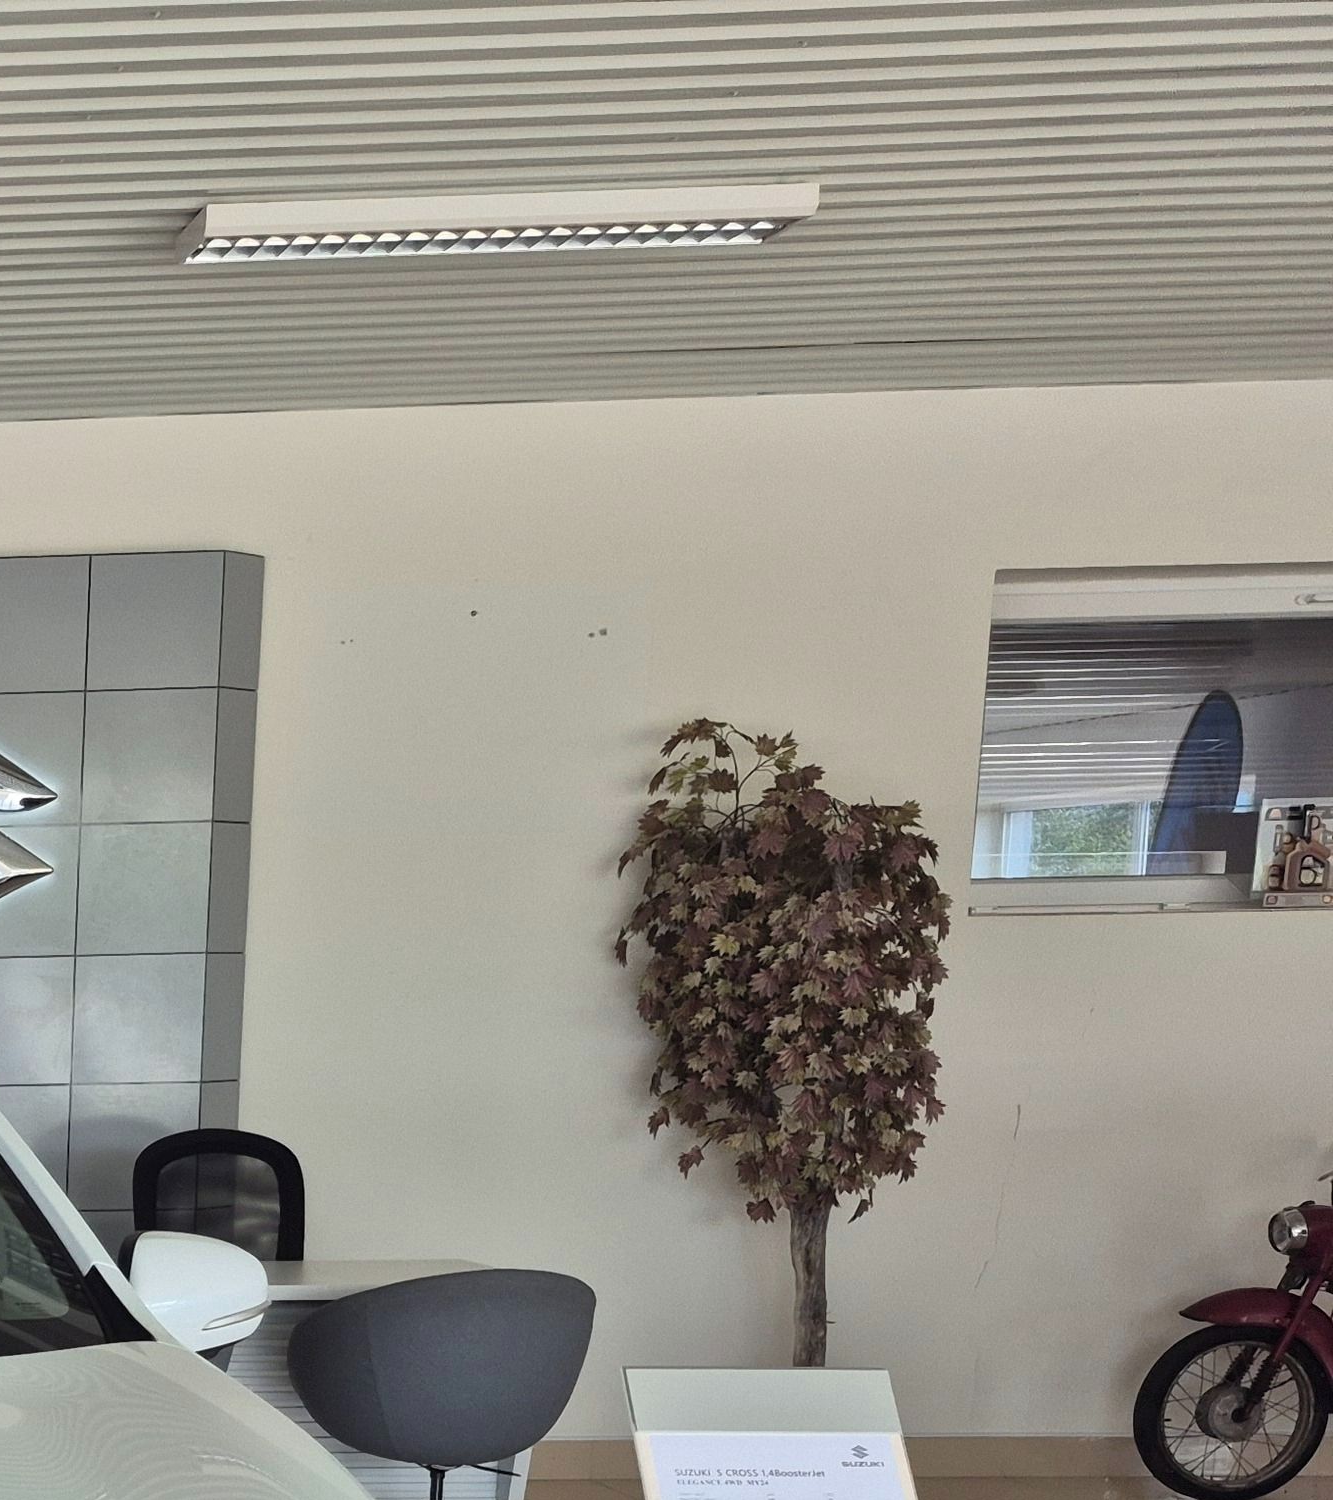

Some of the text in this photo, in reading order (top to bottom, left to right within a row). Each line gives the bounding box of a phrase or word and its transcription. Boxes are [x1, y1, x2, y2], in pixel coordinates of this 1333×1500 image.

[674, 1468, 711, 1477] SUZUKI
[716, 1469, 723, 1477] S
[725, 1469, 759, 1477] CROSS
